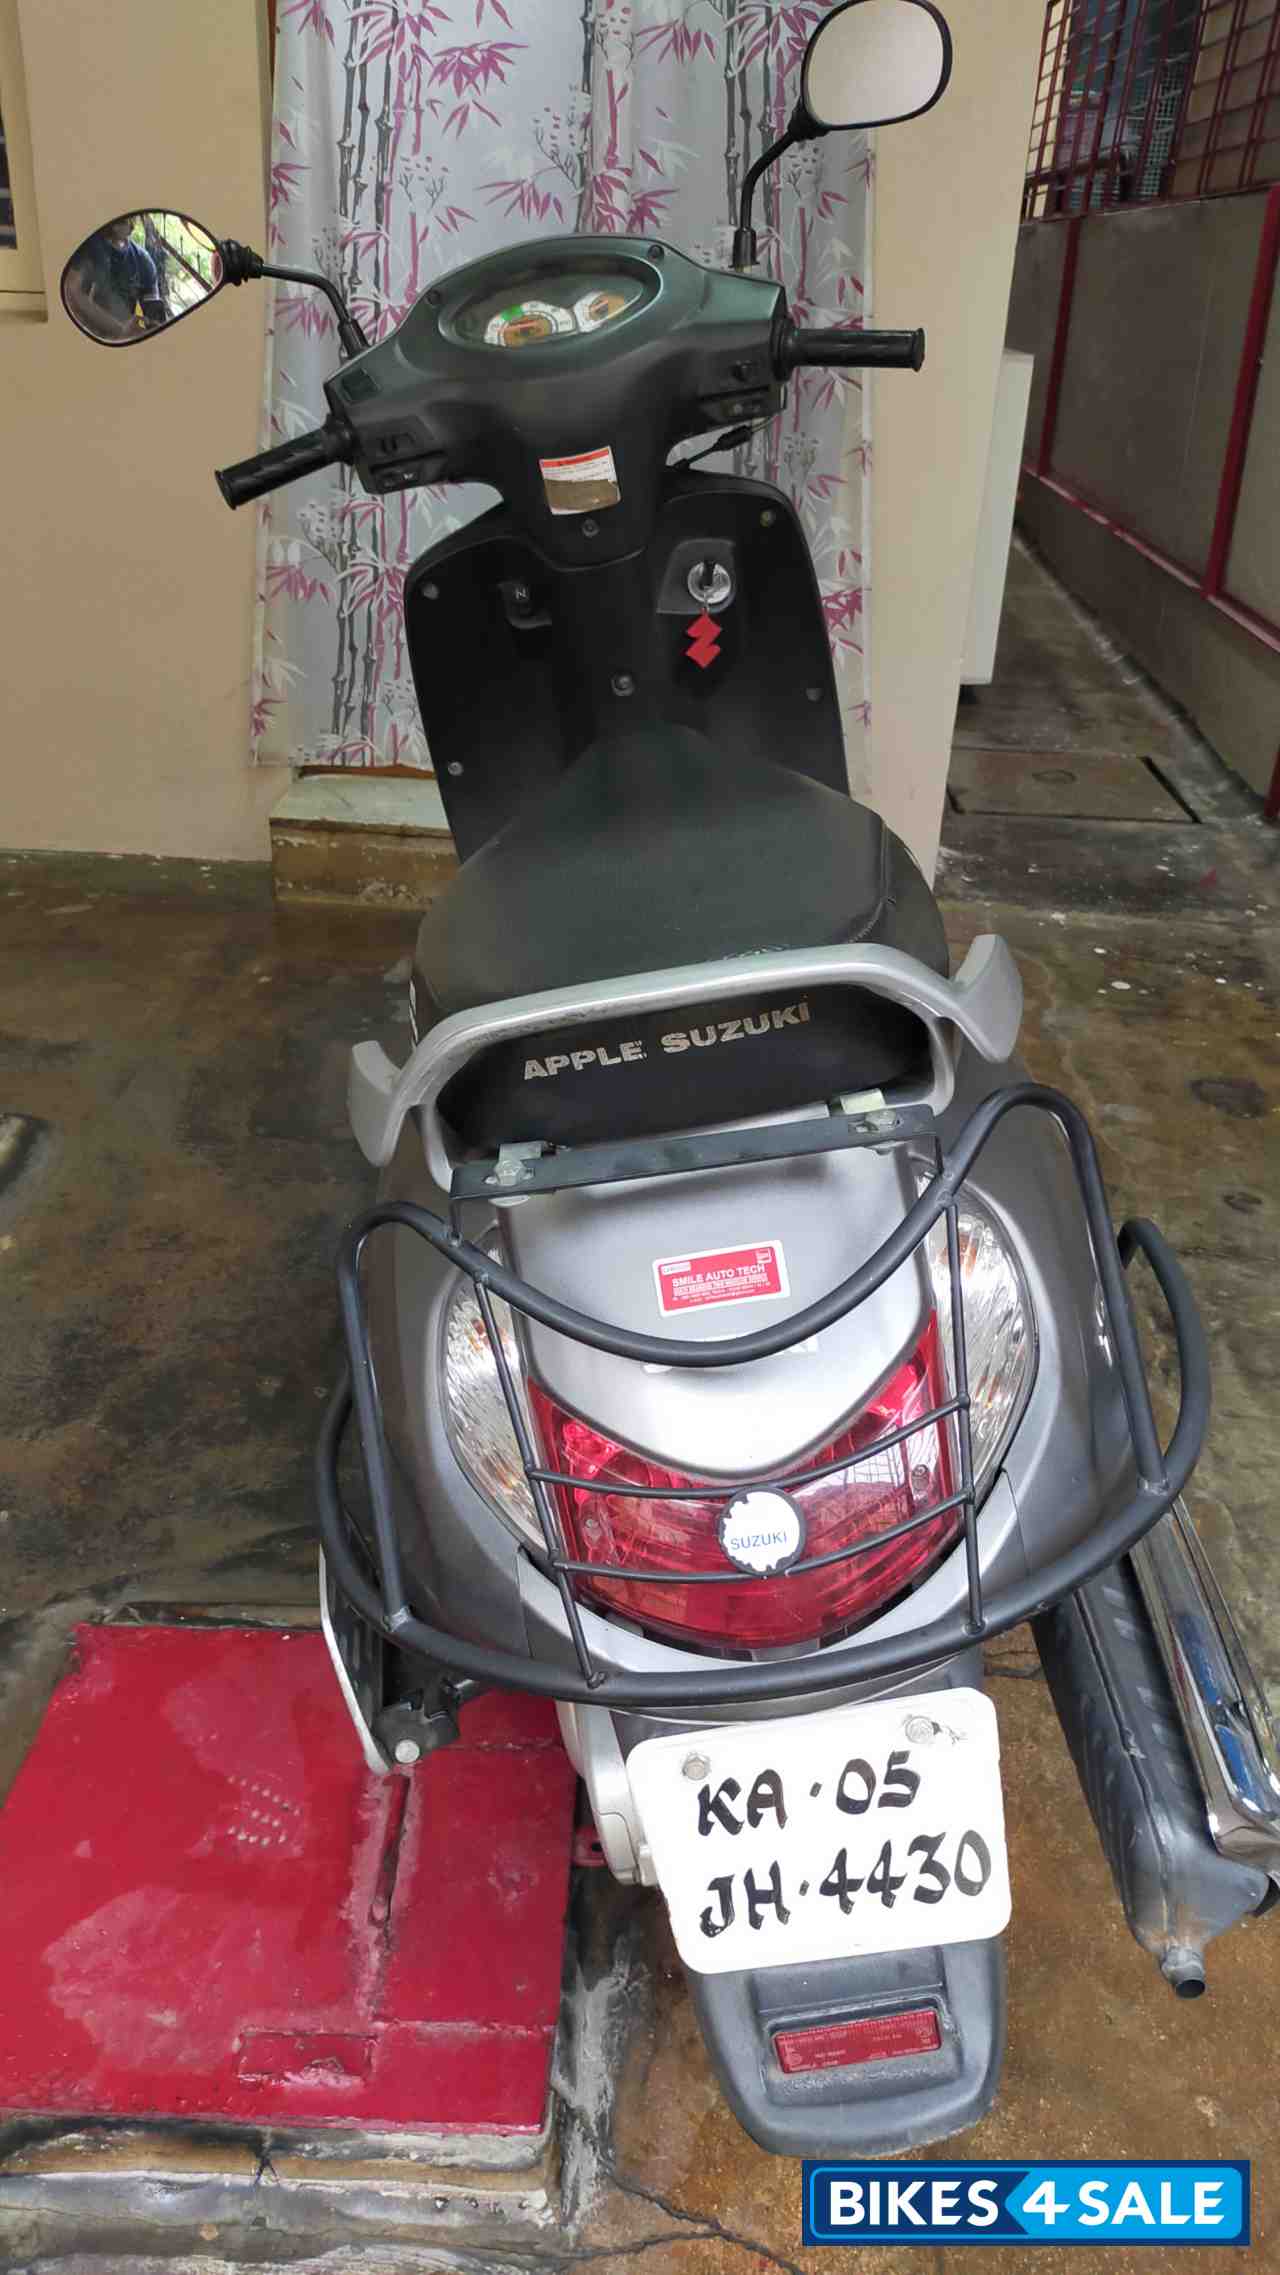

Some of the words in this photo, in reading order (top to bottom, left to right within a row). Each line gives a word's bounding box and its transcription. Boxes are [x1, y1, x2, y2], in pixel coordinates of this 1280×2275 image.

[524, 1039, 646, 1080] APPLE
[671, 1273, 704, 1287] SMILE
[705, 1268, 735, 1282] AUTO
[735, 1263, 766, 1277] TECH
[731, 1530, 787, 1550] SUZUKI
